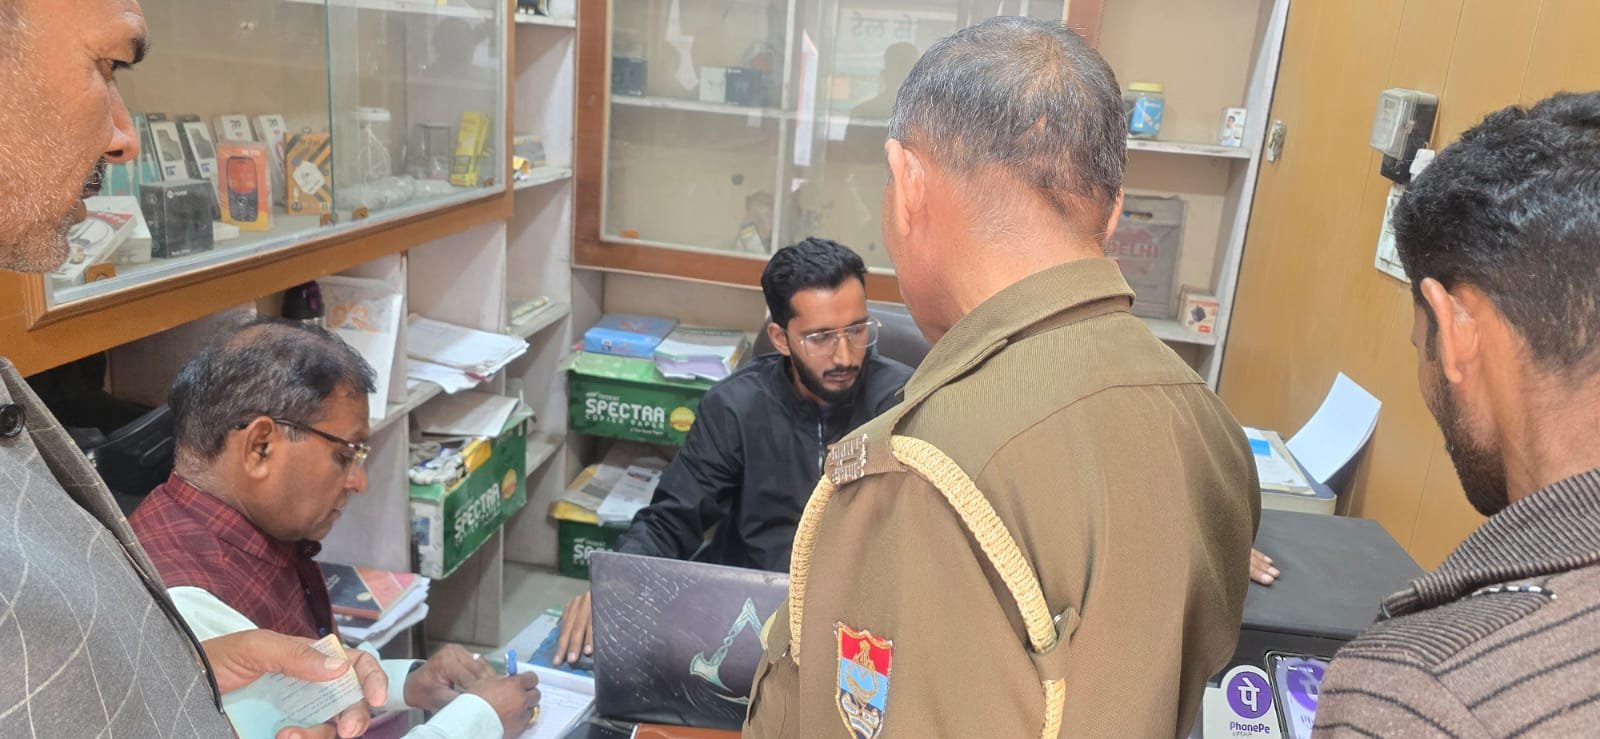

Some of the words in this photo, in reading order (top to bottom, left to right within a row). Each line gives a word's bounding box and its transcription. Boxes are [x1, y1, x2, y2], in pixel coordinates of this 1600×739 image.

[585, 398, 665, 423] SPECTRA
[454, 483, 501, 531] SPECTRA
[1237, 677, 1261, 712] पे
[1230, 721, 1270, 734] PhonePe
